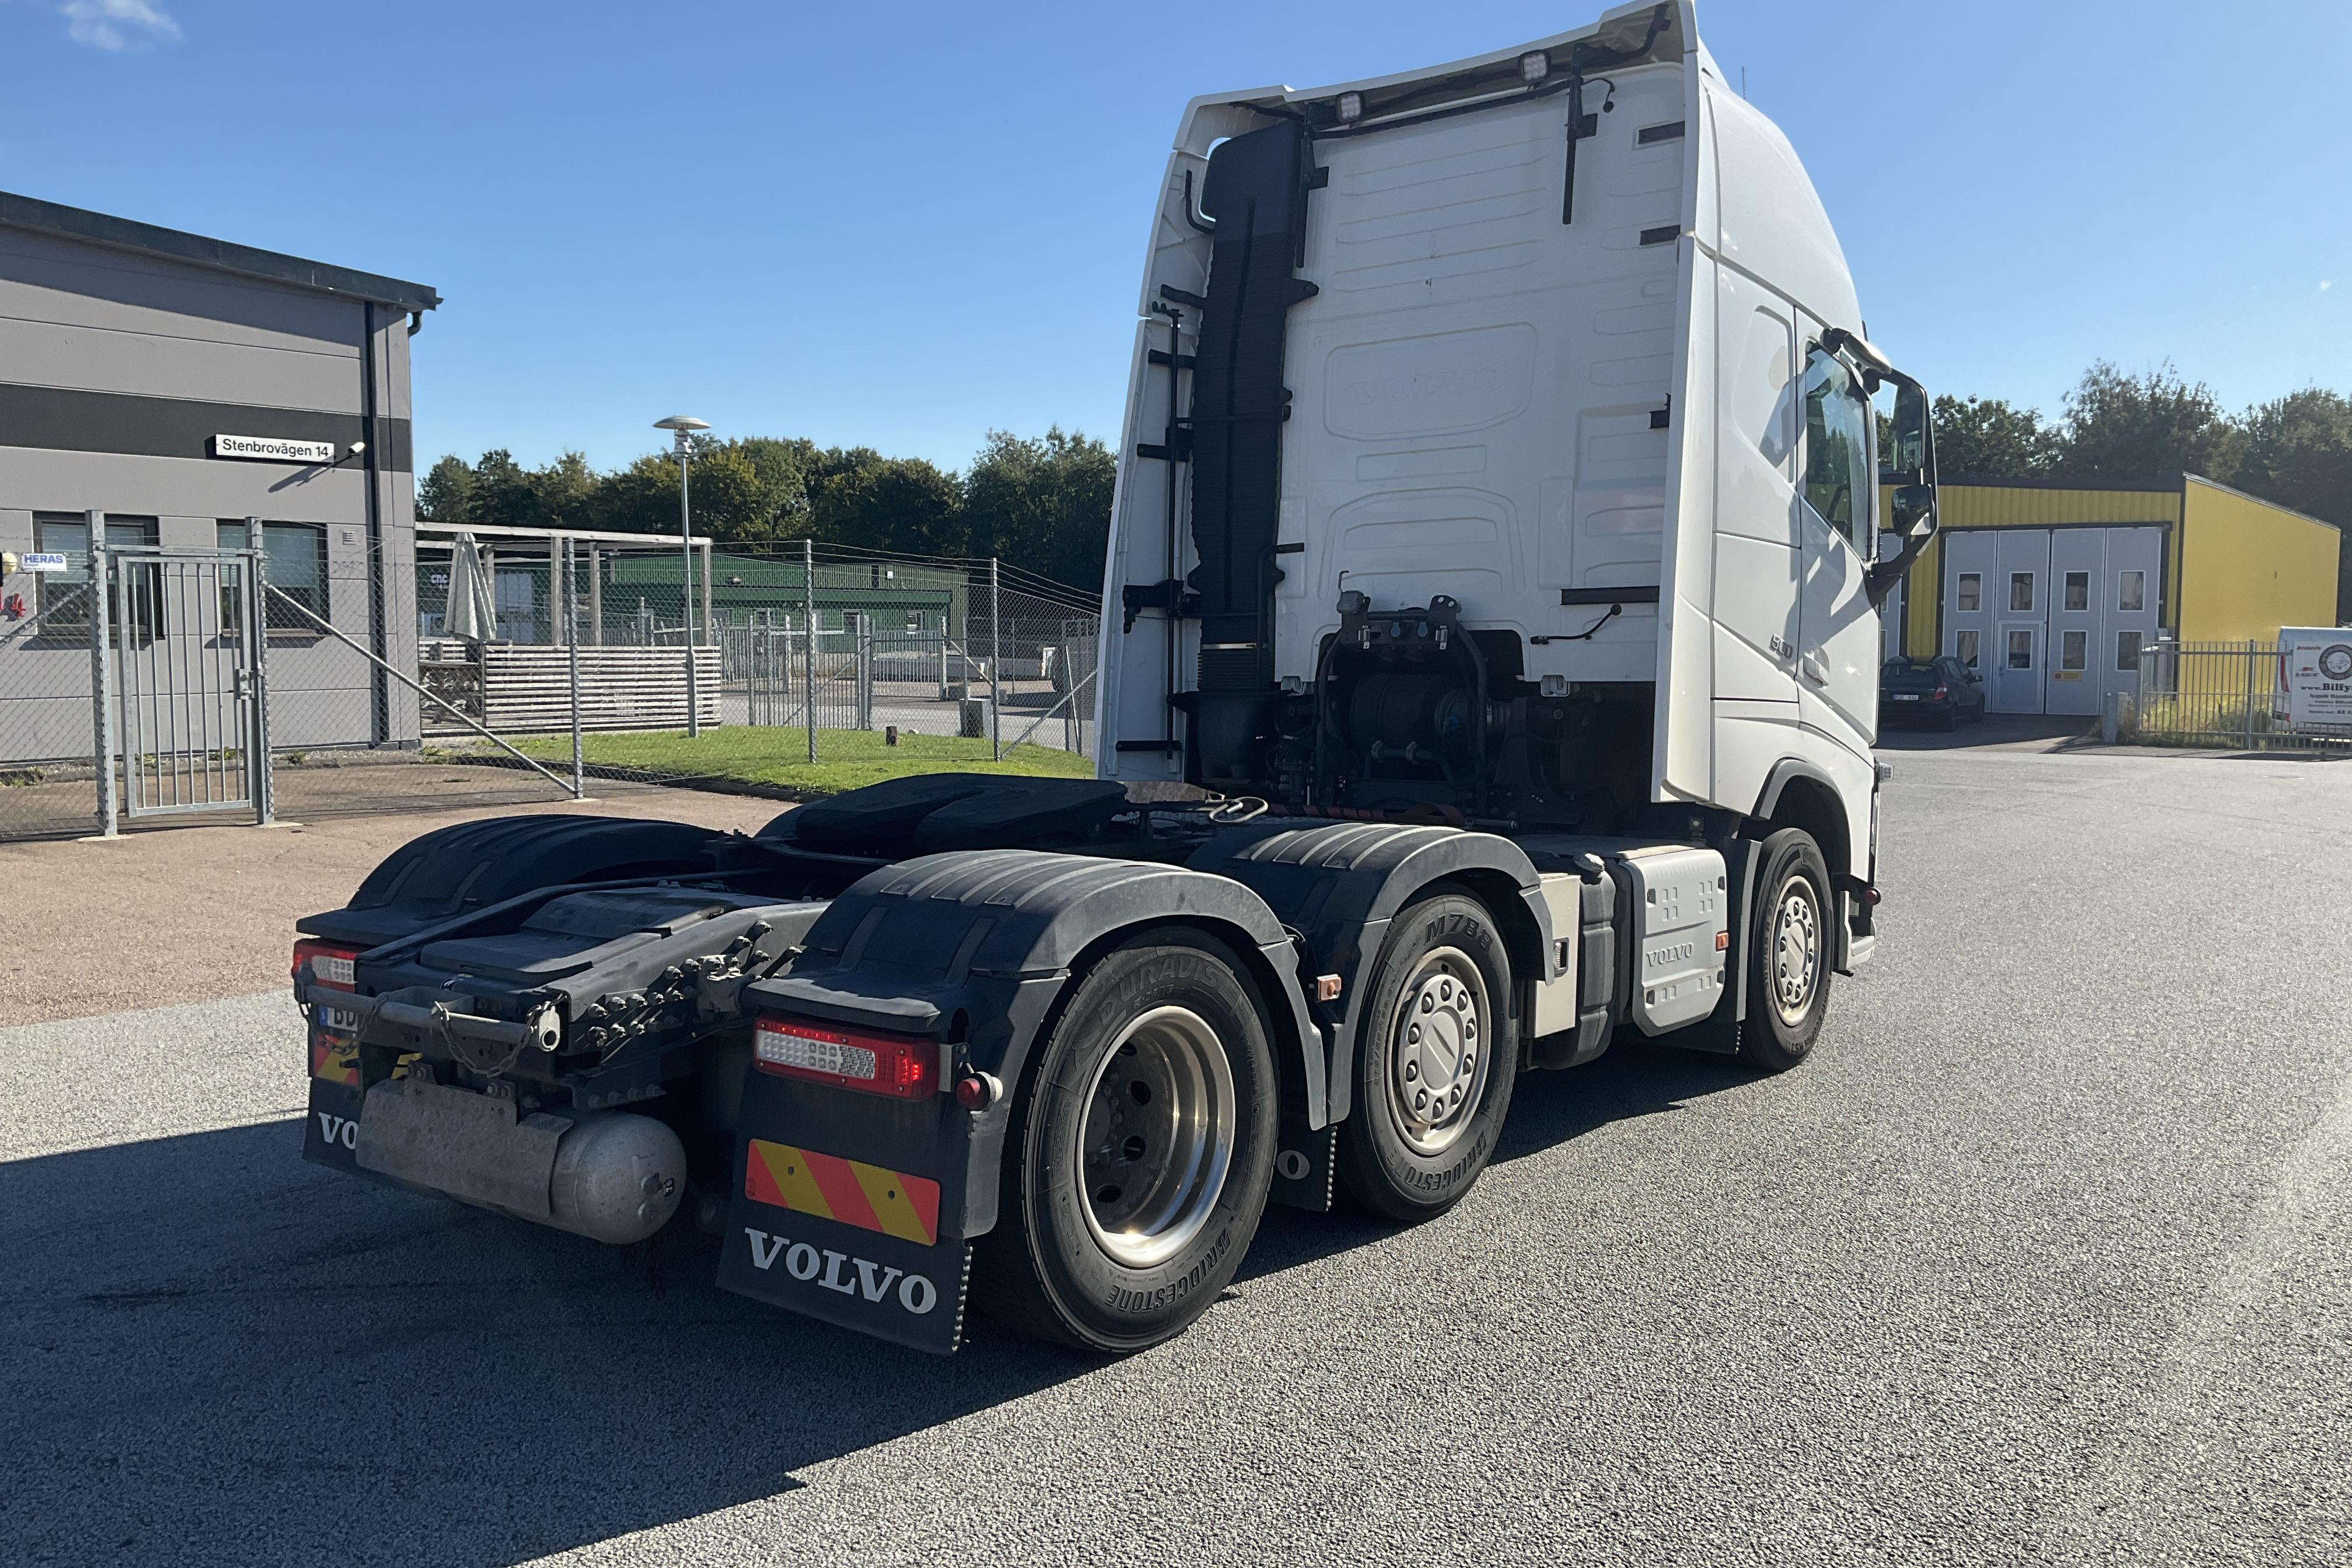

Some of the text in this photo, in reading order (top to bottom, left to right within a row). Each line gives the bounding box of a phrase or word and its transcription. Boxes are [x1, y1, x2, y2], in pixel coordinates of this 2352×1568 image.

[222, 438, 329, 457] Stenbrovägen 14
[24, 554, 64, 563] HERAS
[2301, 683, 2352, 692] www.Bilfy
[1423, 912, 1493, 953] M788
[1646, 942, 1694, 967] VOLVO
[1097, 956, 1220, 1028] DURAVIS
[744, 1227, 937, 1314] VOLVO
[1105, 1227, 1232, 1313] BRIDGESTONE
